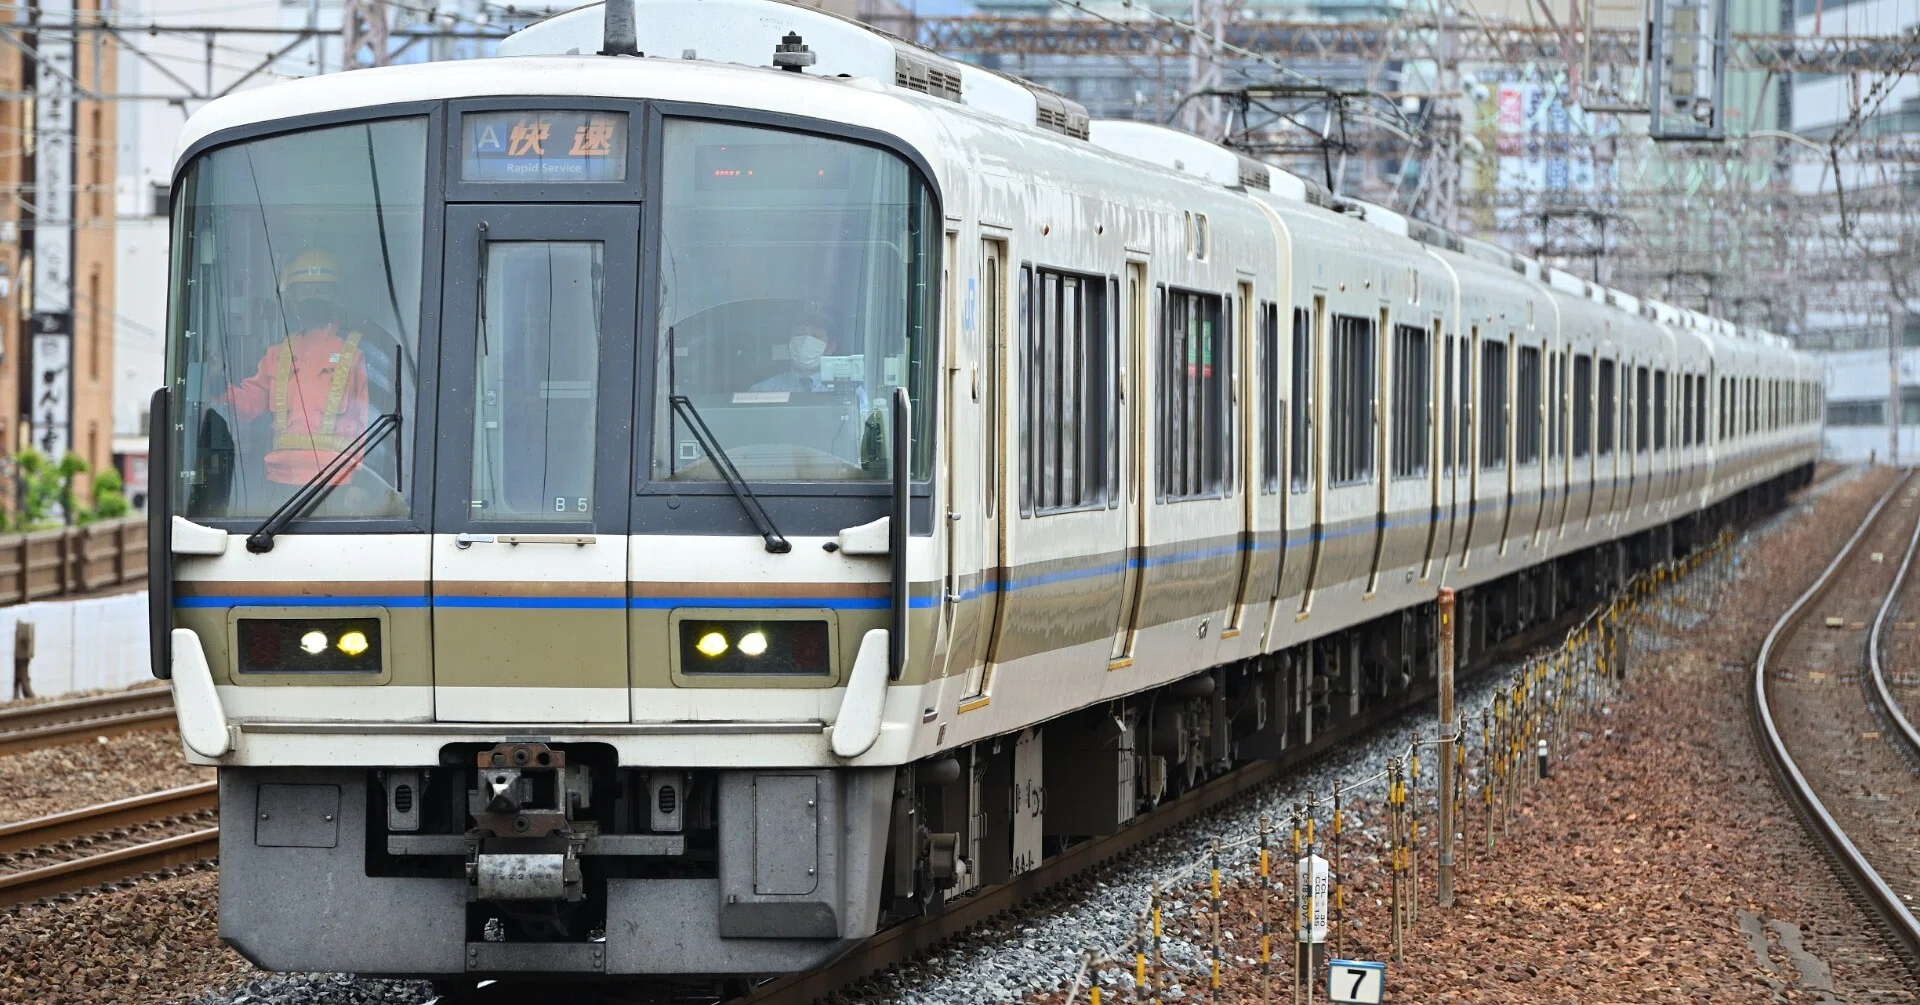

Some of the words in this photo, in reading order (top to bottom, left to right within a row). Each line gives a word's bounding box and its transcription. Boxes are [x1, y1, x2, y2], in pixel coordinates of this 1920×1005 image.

[478, 125, 501, 148] A
[507, 116, 616, 156] 快速
[507, 163, 539, 175] Rapid
[541, 163, 582, 173] Service
[964, 278, 975, 331] JR
[1347, 968, 1367, 999] 7
